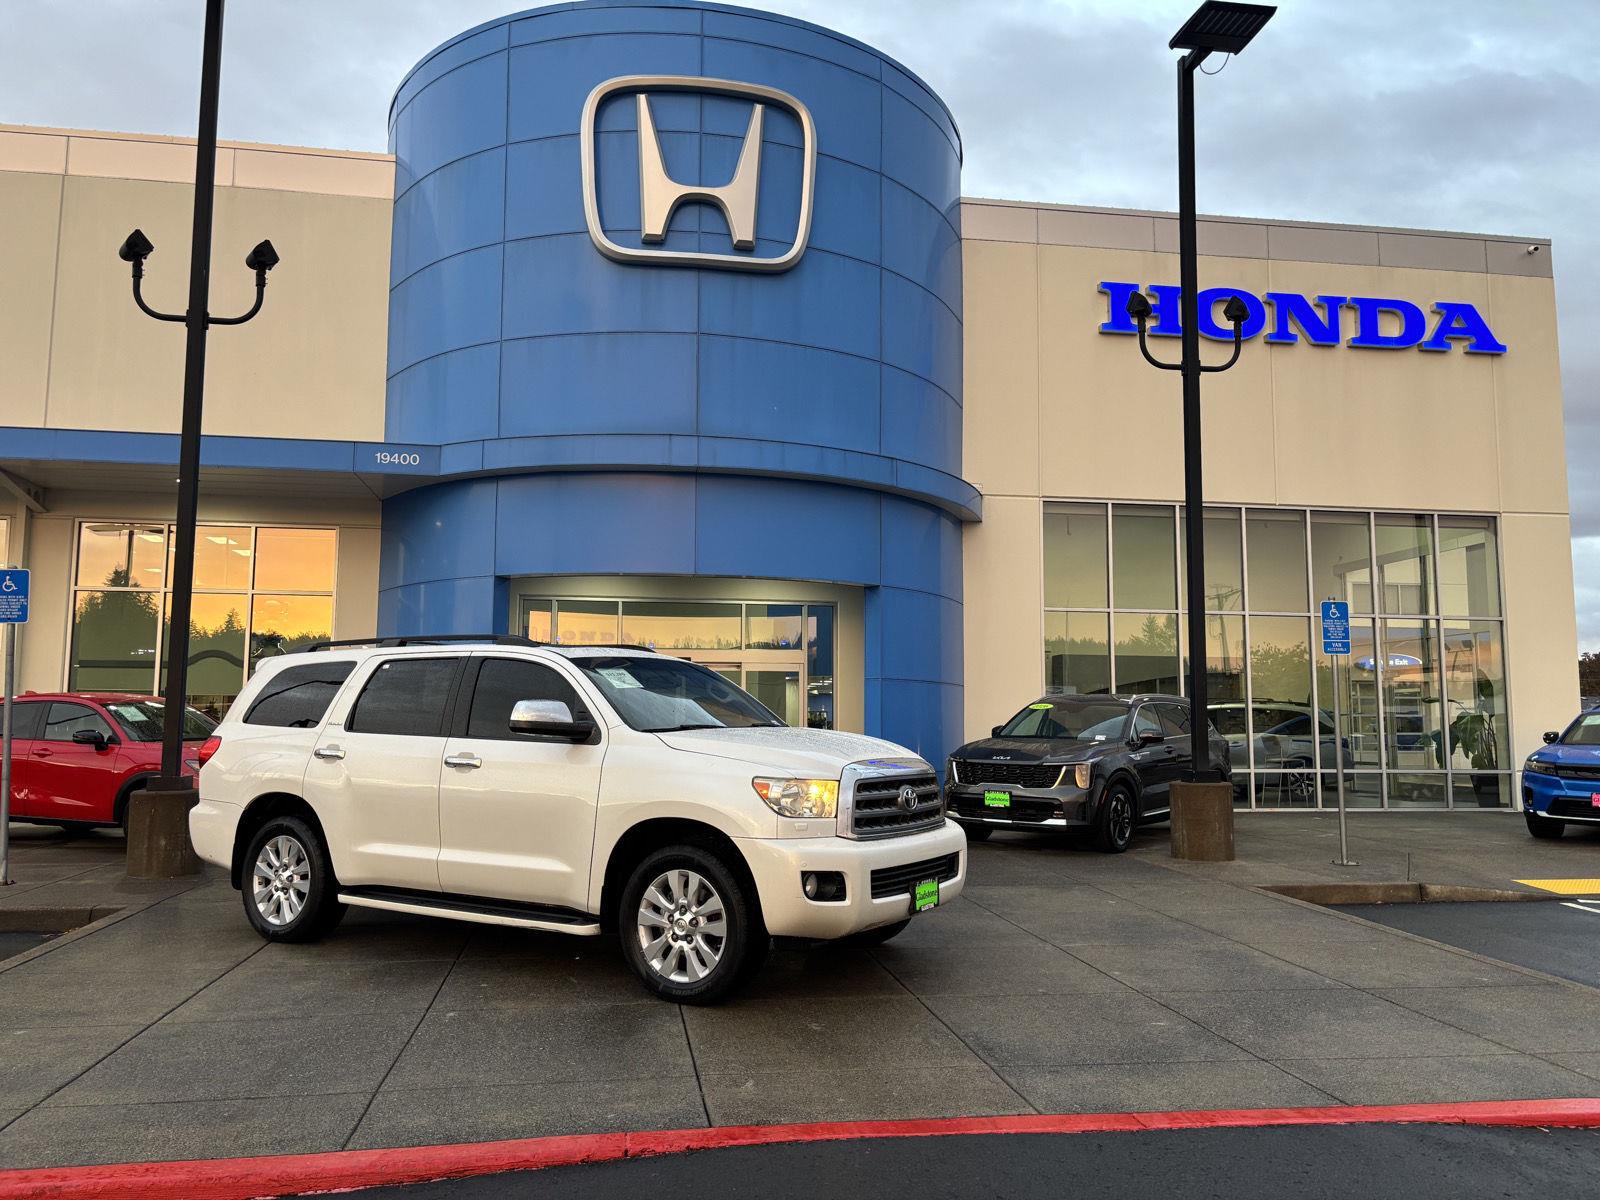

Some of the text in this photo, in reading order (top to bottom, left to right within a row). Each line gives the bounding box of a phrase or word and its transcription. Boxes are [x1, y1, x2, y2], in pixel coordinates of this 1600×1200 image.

[1097, 281, 1507, 354] HONDA
[375, 452, 420, 465] 19400
[1395, 658, 1408, 666] Exit
